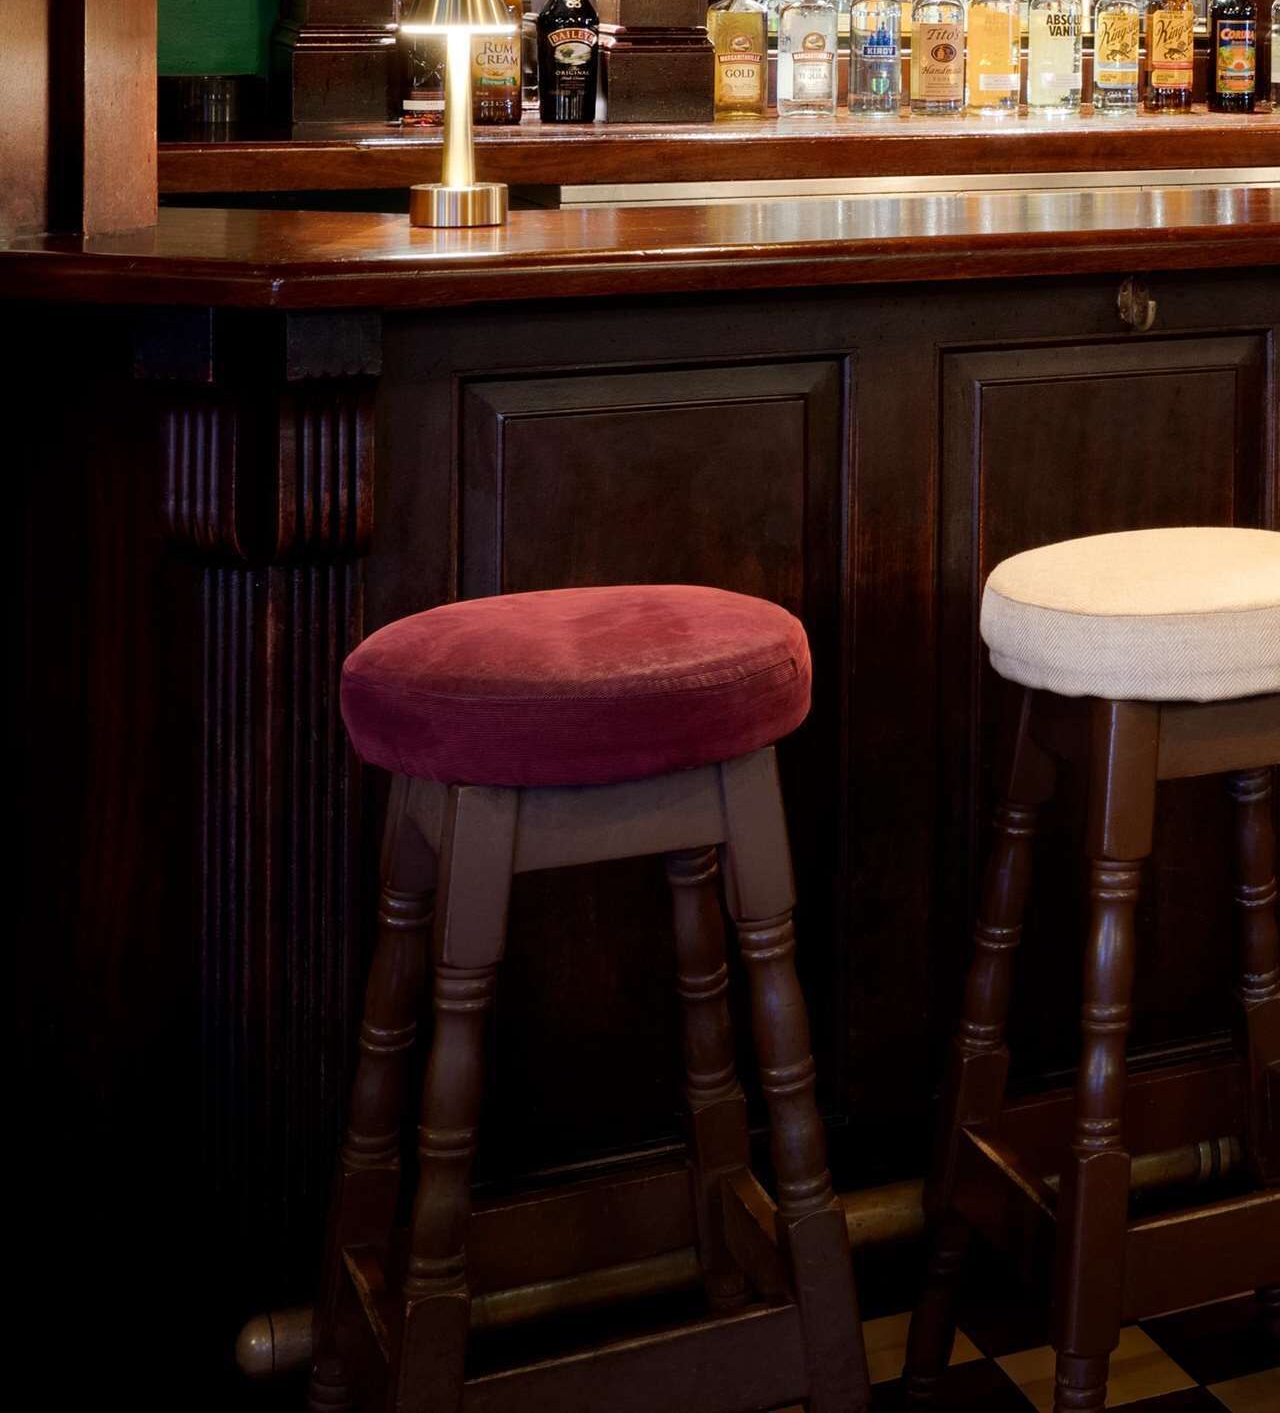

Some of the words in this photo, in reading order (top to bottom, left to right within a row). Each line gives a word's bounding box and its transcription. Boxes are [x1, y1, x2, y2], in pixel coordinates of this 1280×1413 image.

[551, 30, 595, 43] BAILEYS
[927, 28, 961, 41] Tito's
[483, 41, 513, 55] RUM
[475, 52, 519, 68] CREAM
[725, 68, 755, 79] GOLD
